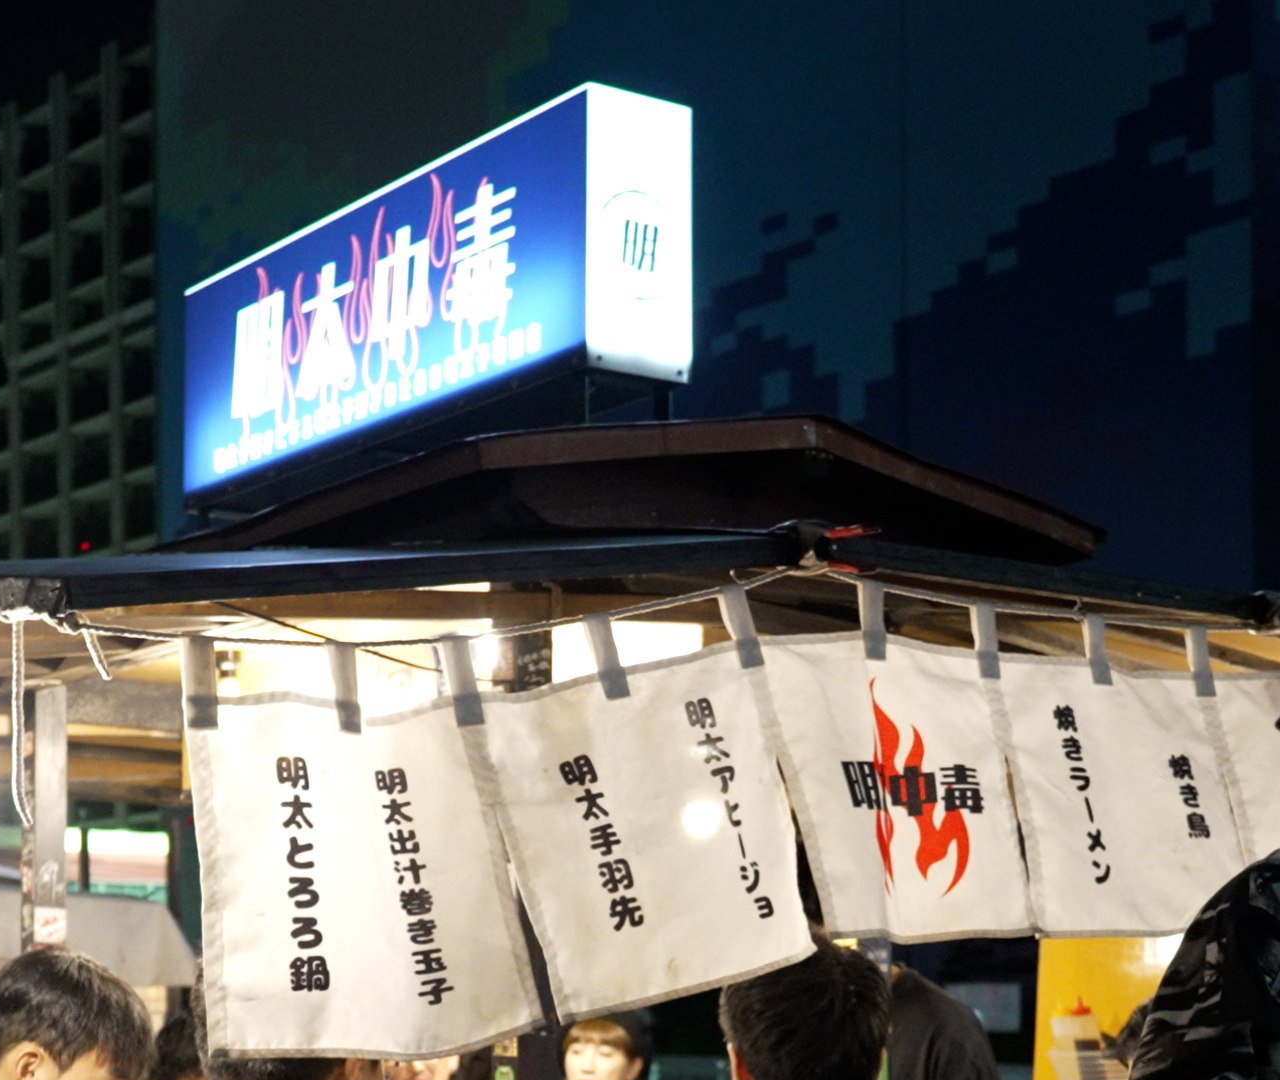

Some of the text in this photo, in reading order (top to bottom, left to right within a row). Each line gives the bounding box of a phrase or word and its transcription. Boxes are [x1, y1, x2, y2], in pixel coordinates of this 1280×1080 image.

[622, 219, 659, 272] 明
[276, 756, 331, 993] 明太とろろ鍋
[559, 754, 645, 932] 明太手羽先
[1052, 705, 1111, 885] 焼きラーメン
[1168, 754, 1211, 840] 焼き鳥
[373, 767, 455, 1006] 明太出汁巻き玉子
